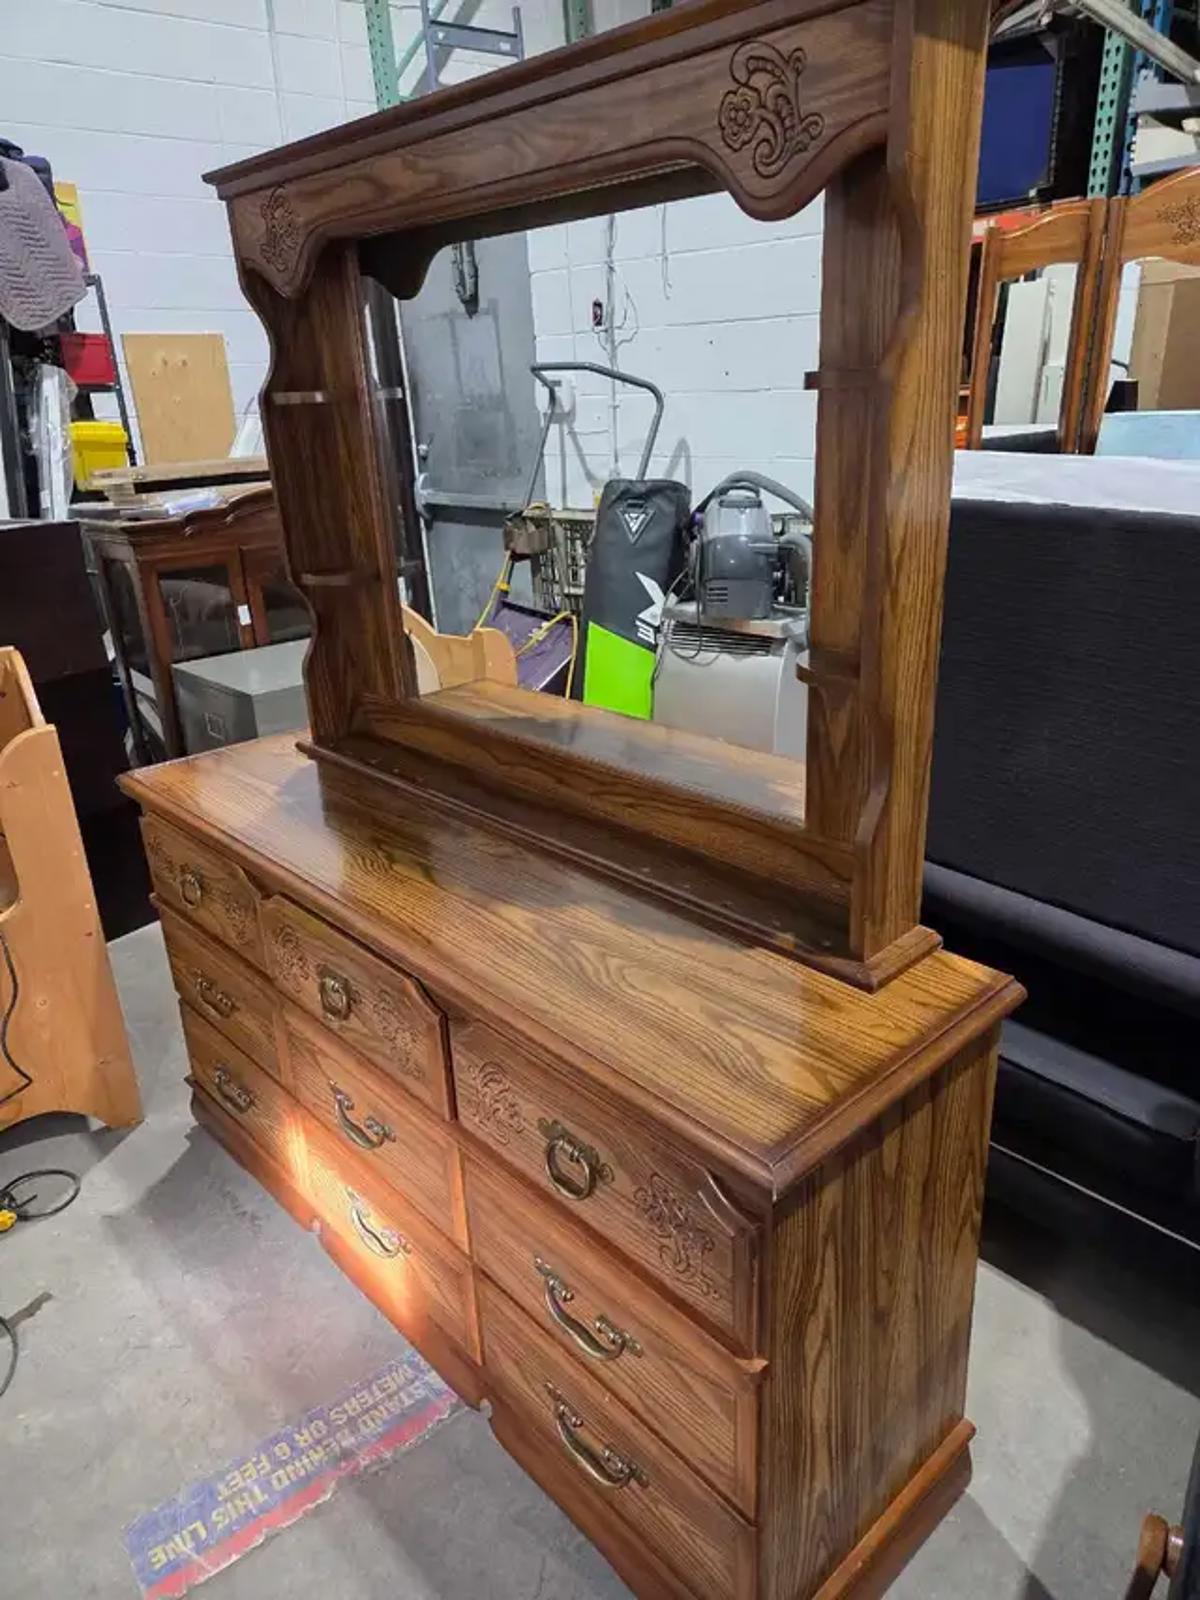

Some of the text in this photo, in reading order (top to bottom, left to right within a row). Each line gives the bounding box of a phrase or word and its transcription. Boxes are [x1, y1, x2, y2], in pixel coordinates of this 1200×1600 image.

[147, 1379, 426, 1570] STAND BEHIND THIS LINE
[216, 1363, 413, 1502] METERS OR 6 FEET
